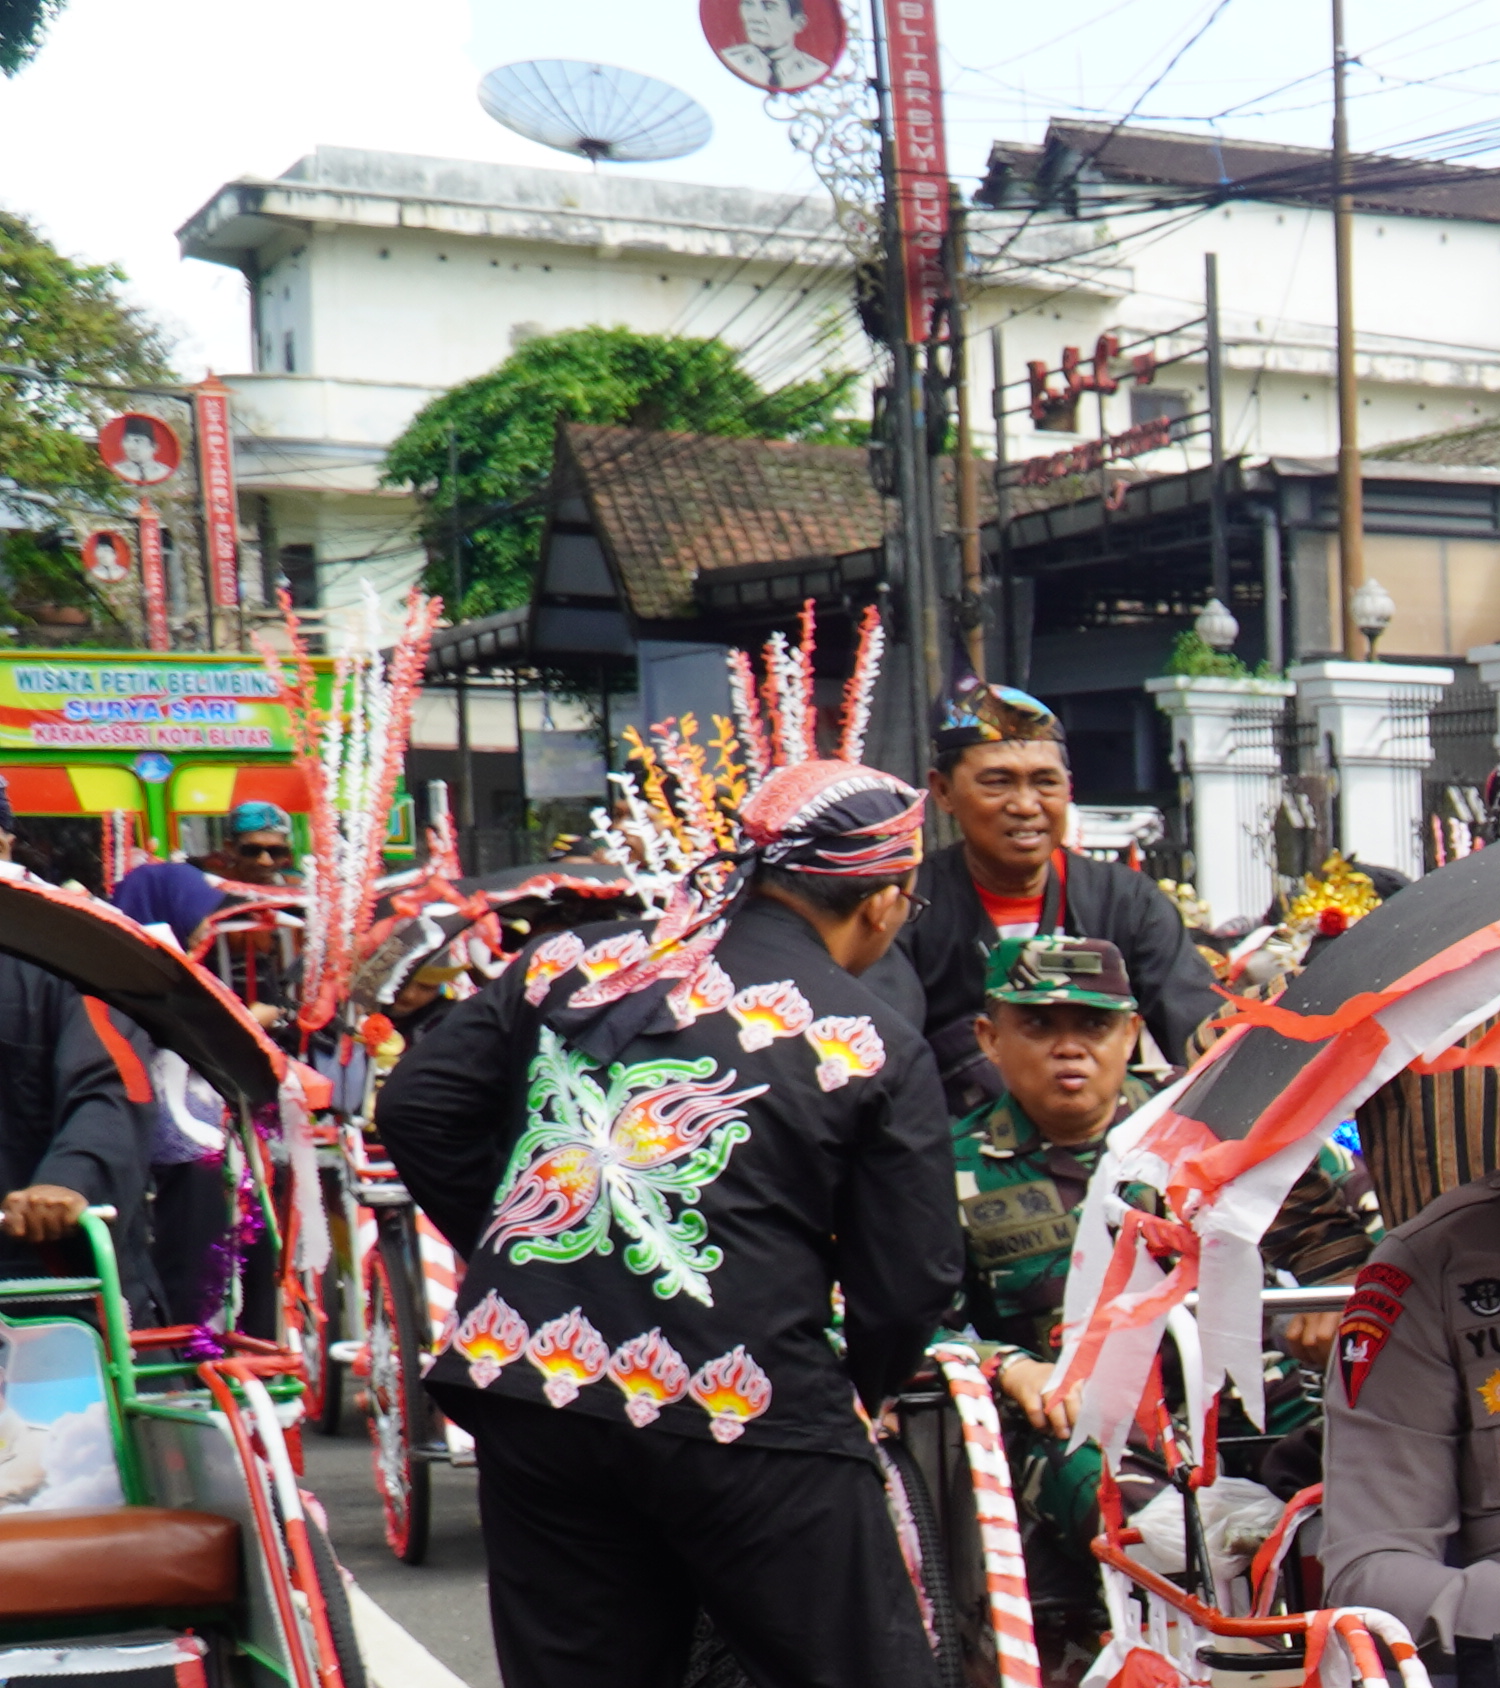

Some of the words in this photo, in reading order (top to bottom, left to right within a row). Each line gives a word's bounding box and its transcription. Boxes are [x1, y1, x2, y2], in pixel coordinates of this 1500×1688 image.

[14, 667, 96, 694] WISATA
[100, 669, 161, 696] PETIK
[64, 698, 165, 723] SURYA
[168, 699, 239, 723] SARI
[31, 723, 152, 746] KARANGSARI
[155, 725, 206, 747] KOTA
[207, 726, 272, 748] BLITAR
